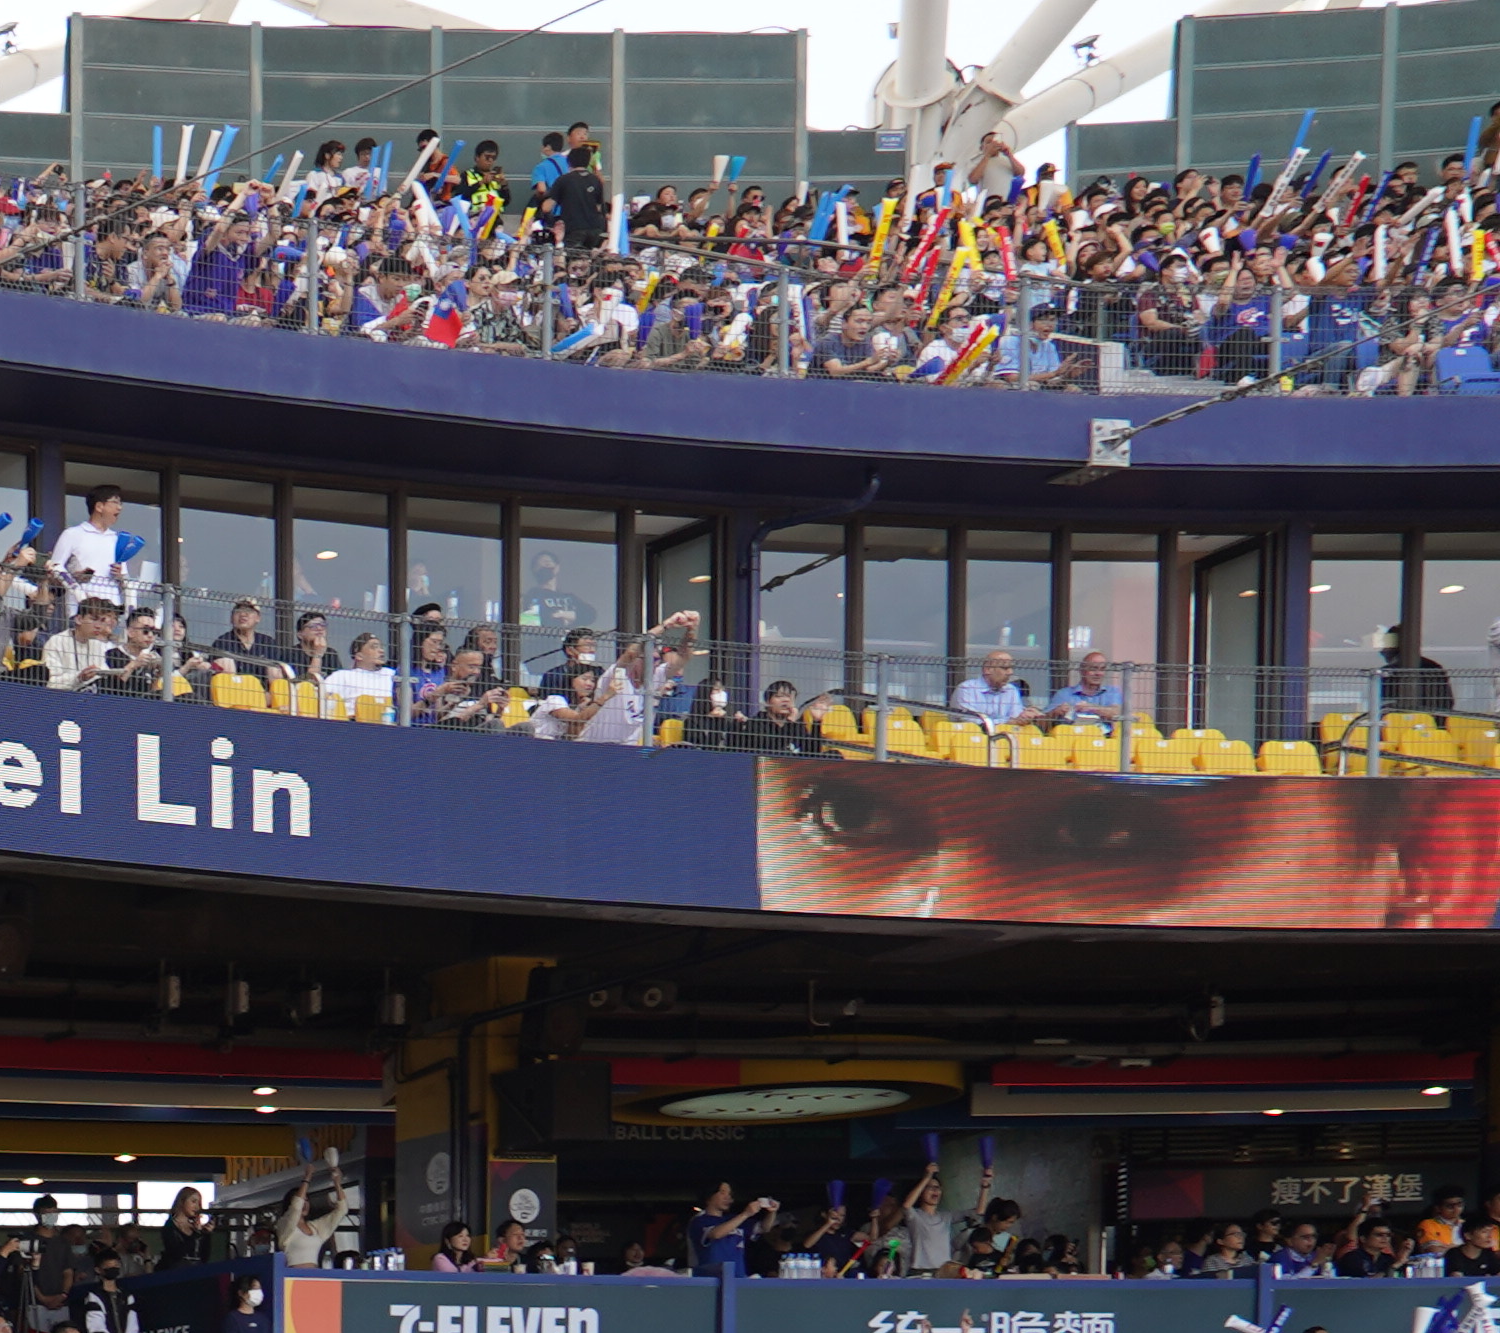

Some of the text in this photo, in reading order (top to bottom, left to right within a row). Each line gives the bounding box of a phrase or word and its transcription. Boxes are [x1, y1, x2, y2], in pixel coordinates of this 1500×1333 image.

[137, 735, 311, 837] Lin
[614, 1125, 662, 1141] BALL
[666, 1126, 746, 1142] CLASSIC
[1271, 1173, 1424, 1205] 瘦不了漢堡
